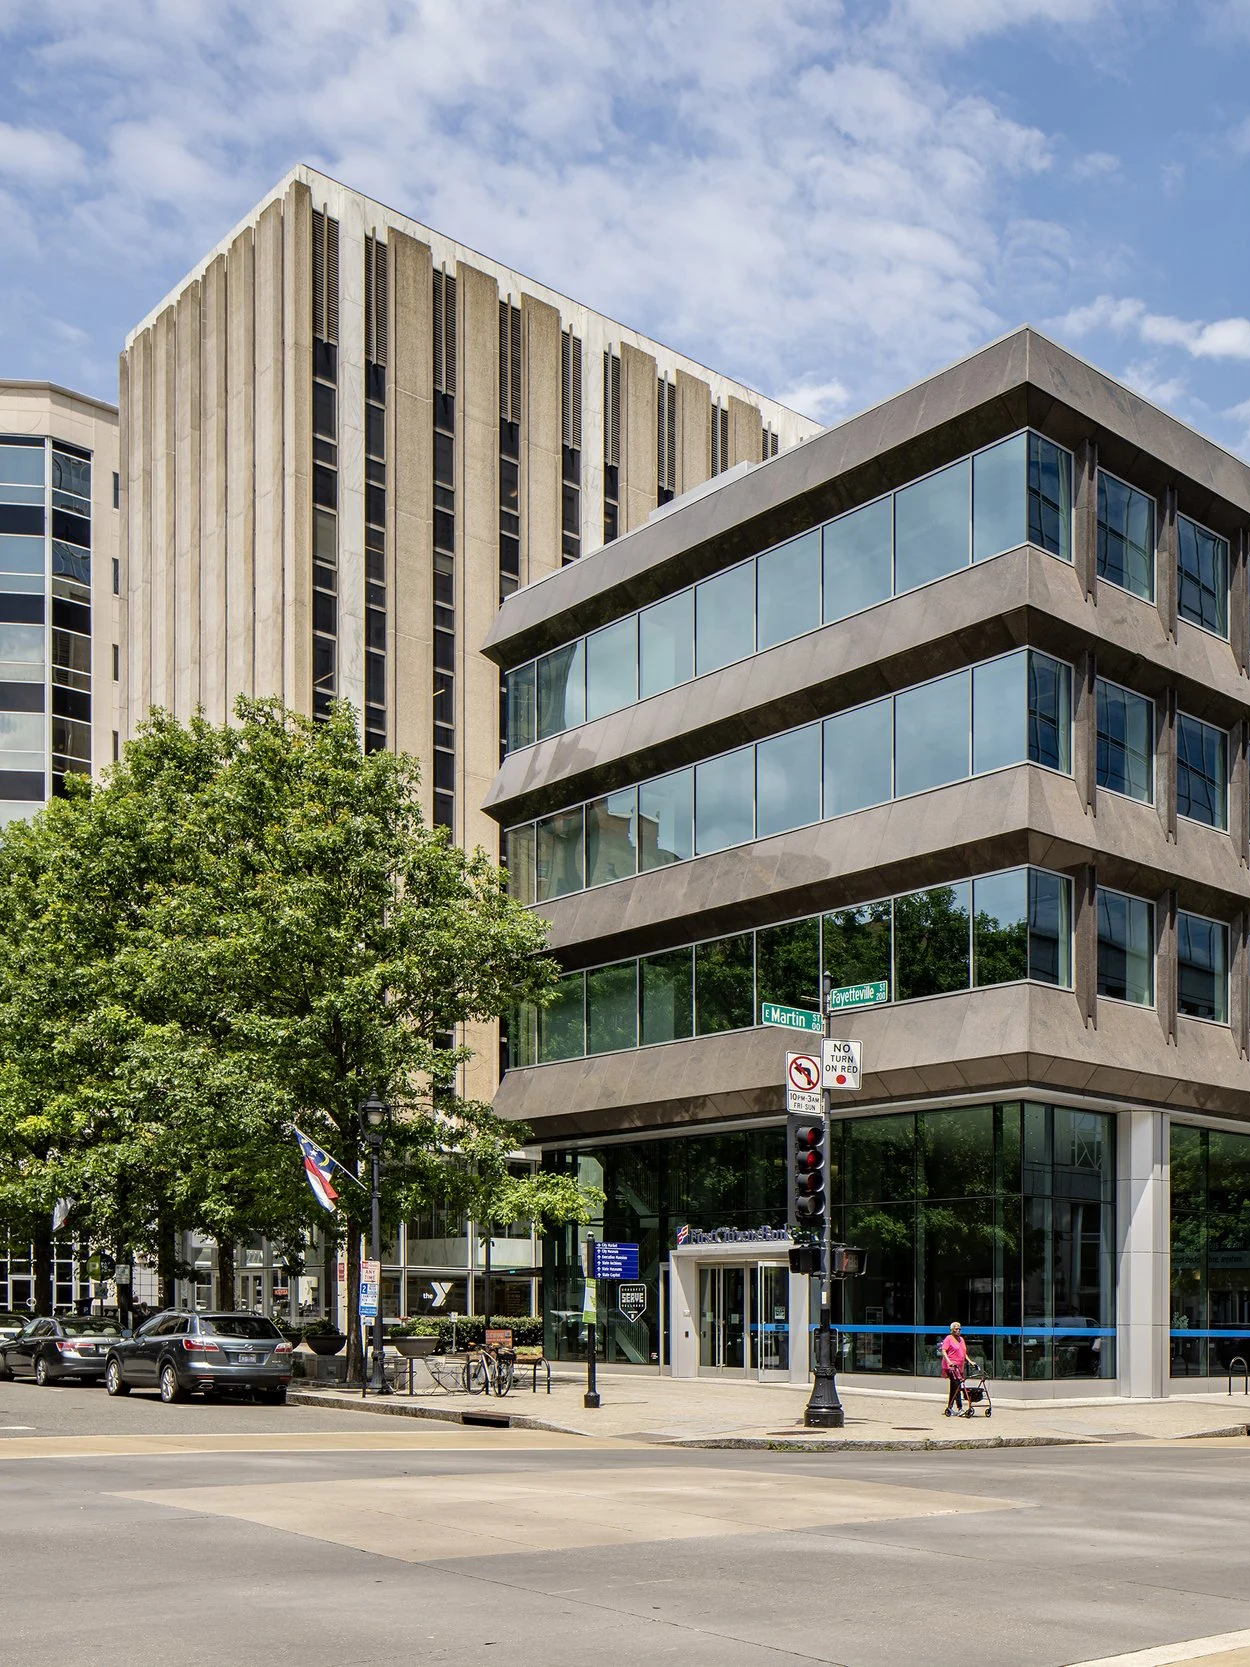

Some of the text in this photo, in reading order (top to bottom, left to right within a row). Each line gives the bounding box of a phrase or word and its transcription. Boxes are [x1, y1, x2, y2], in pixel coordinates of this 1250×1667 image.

[832, 983, 886, 1006] Fayetteville ST
[876, 992, 886, 1001] 200
[765, 1007, 821, 1028] E Martin ST
[811, 1022, 821, 1031] 00
[833, 1043, 851, 1053] NO
[830, 1054, 854, 1063] TURN
[825, 1064, 859, 1074] ON RED
[362, 1285, 367, 1293] 2
[621, 1292, 644, 1303] SERVE
